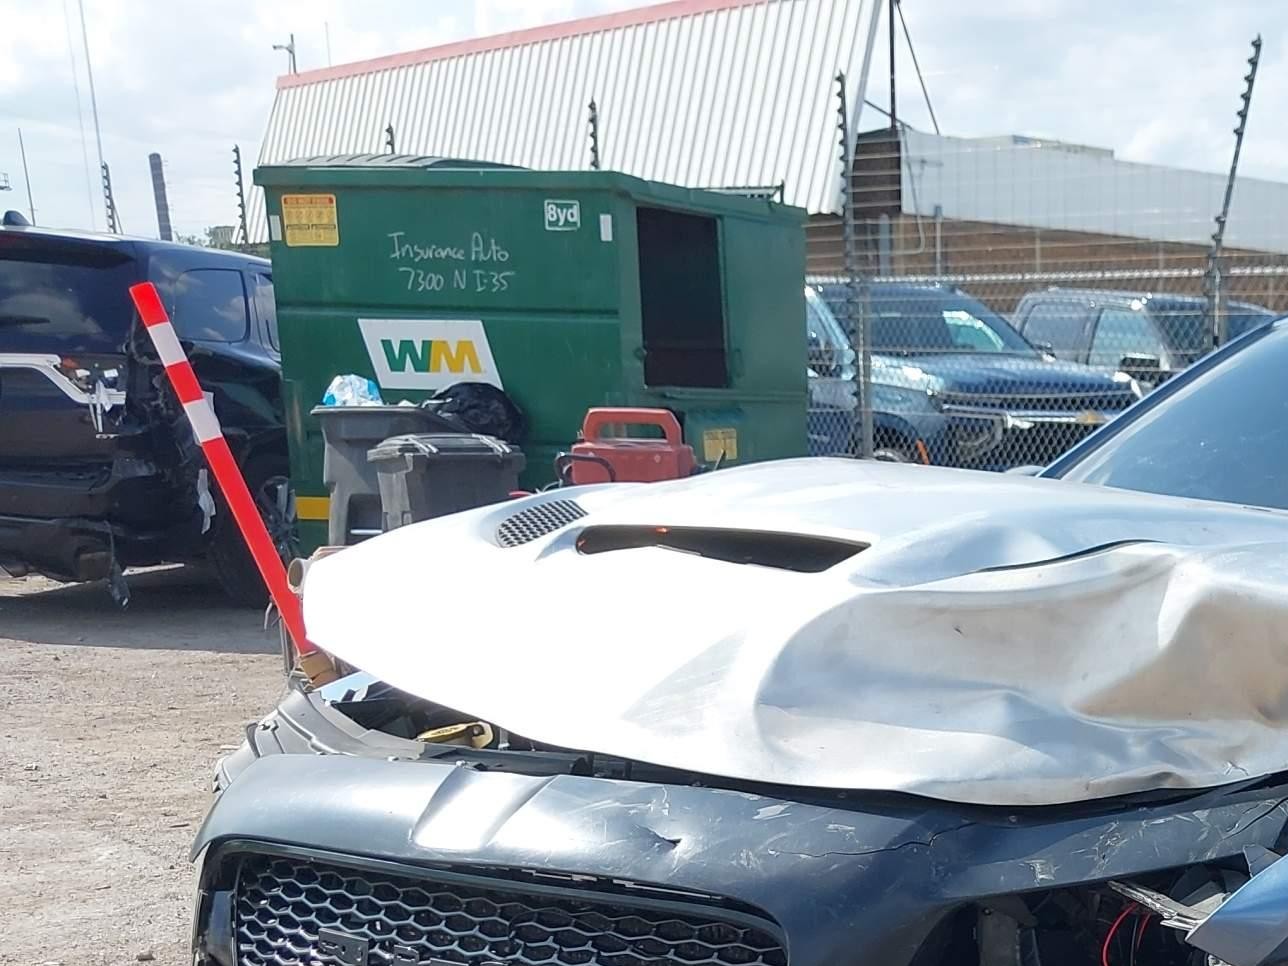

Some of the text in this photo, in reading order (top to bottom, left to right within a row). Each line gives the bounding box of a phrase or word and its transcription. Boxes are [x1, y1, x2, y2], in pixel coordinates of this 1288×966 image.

[547, 204, 578, 226] 8yd
[388, 231, 510, 261] Insurance Auto
[398, 267, 444, 292] 7300
[453, 269, 466, 290] N
[380, 339, 482, 372] WM
